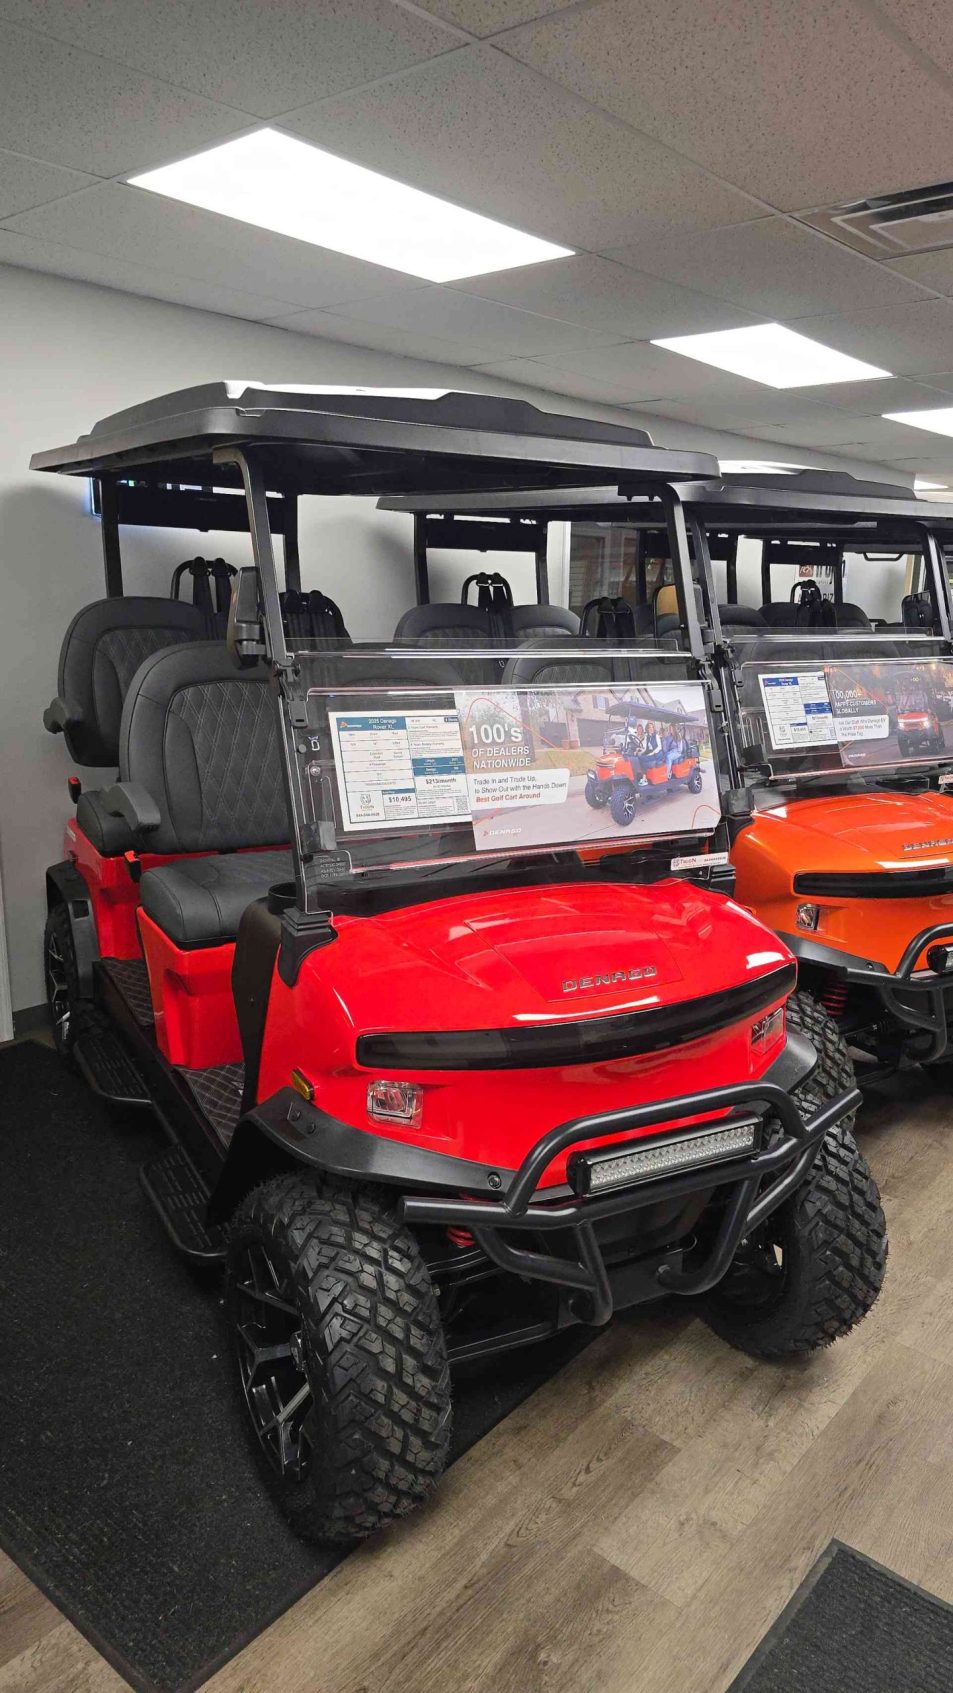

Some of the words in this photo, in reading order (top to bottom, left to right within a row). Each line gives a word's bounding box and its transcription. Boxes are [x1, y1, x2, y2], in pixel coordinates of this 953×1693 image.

[469, 724, 523, 744] 100's
[472, 748, 484, 758] OF
[486, 746, 530, 756] DEALERS
[474, 758, 531, 769] NATIONWIDE
[482, 786, 497, 794] Show
[510, 784, 521, 792] with
[491, 794, 504, 802] Golf
[562, 966, 657, 993] DENAGO
